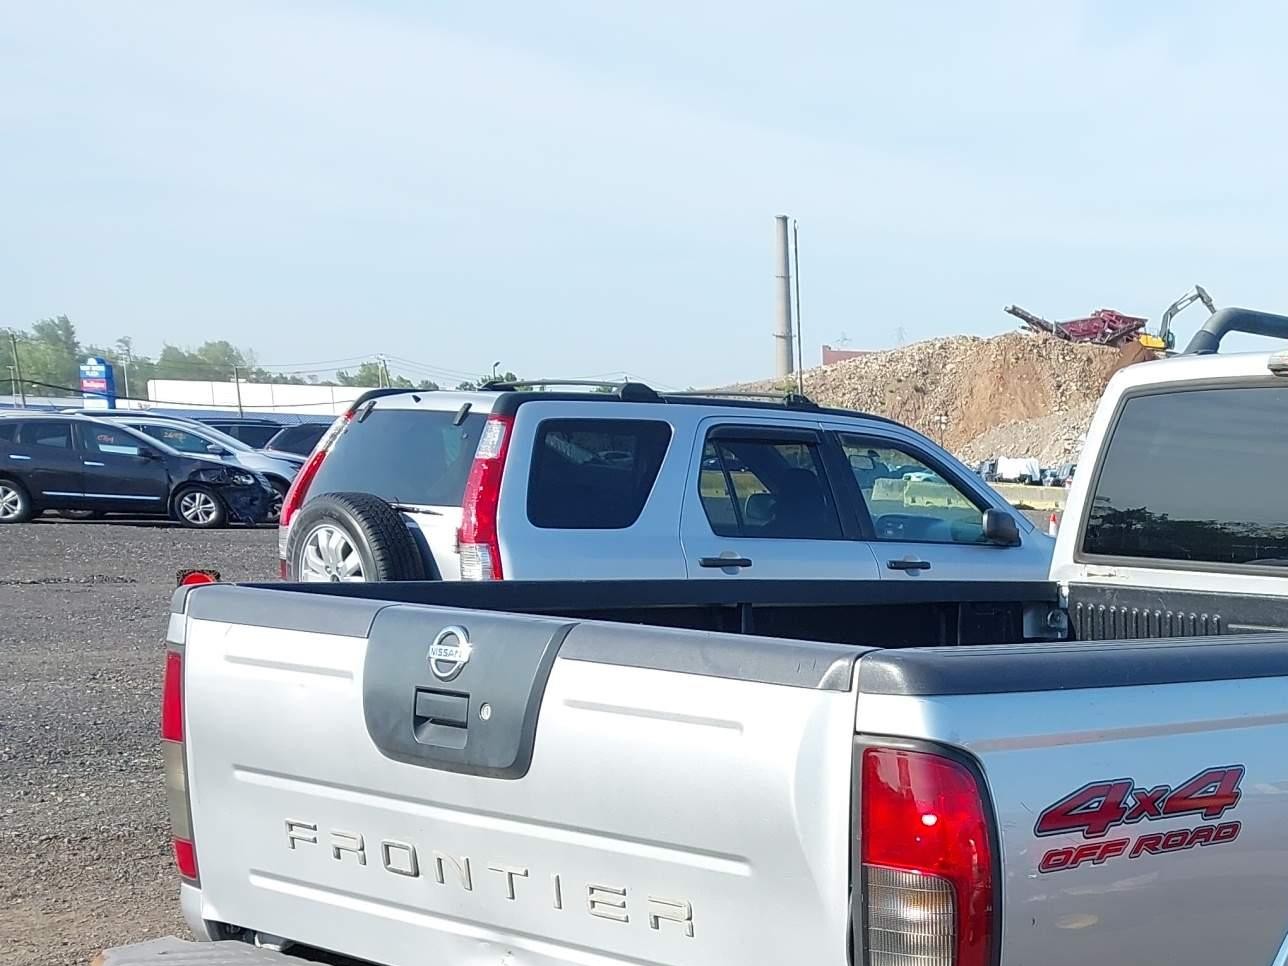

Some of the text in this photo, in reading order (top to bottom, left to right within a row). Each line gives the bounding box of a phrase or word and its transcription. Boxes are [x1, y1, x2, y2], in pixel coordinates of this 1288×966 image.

[430, 646, 464, 659] NISSAN
[1034, 764, 1246, 839] 4x4
[285, 817, 695, 938] FRONTIER
[1038, 821, 1242, 874] OFF ROAD
